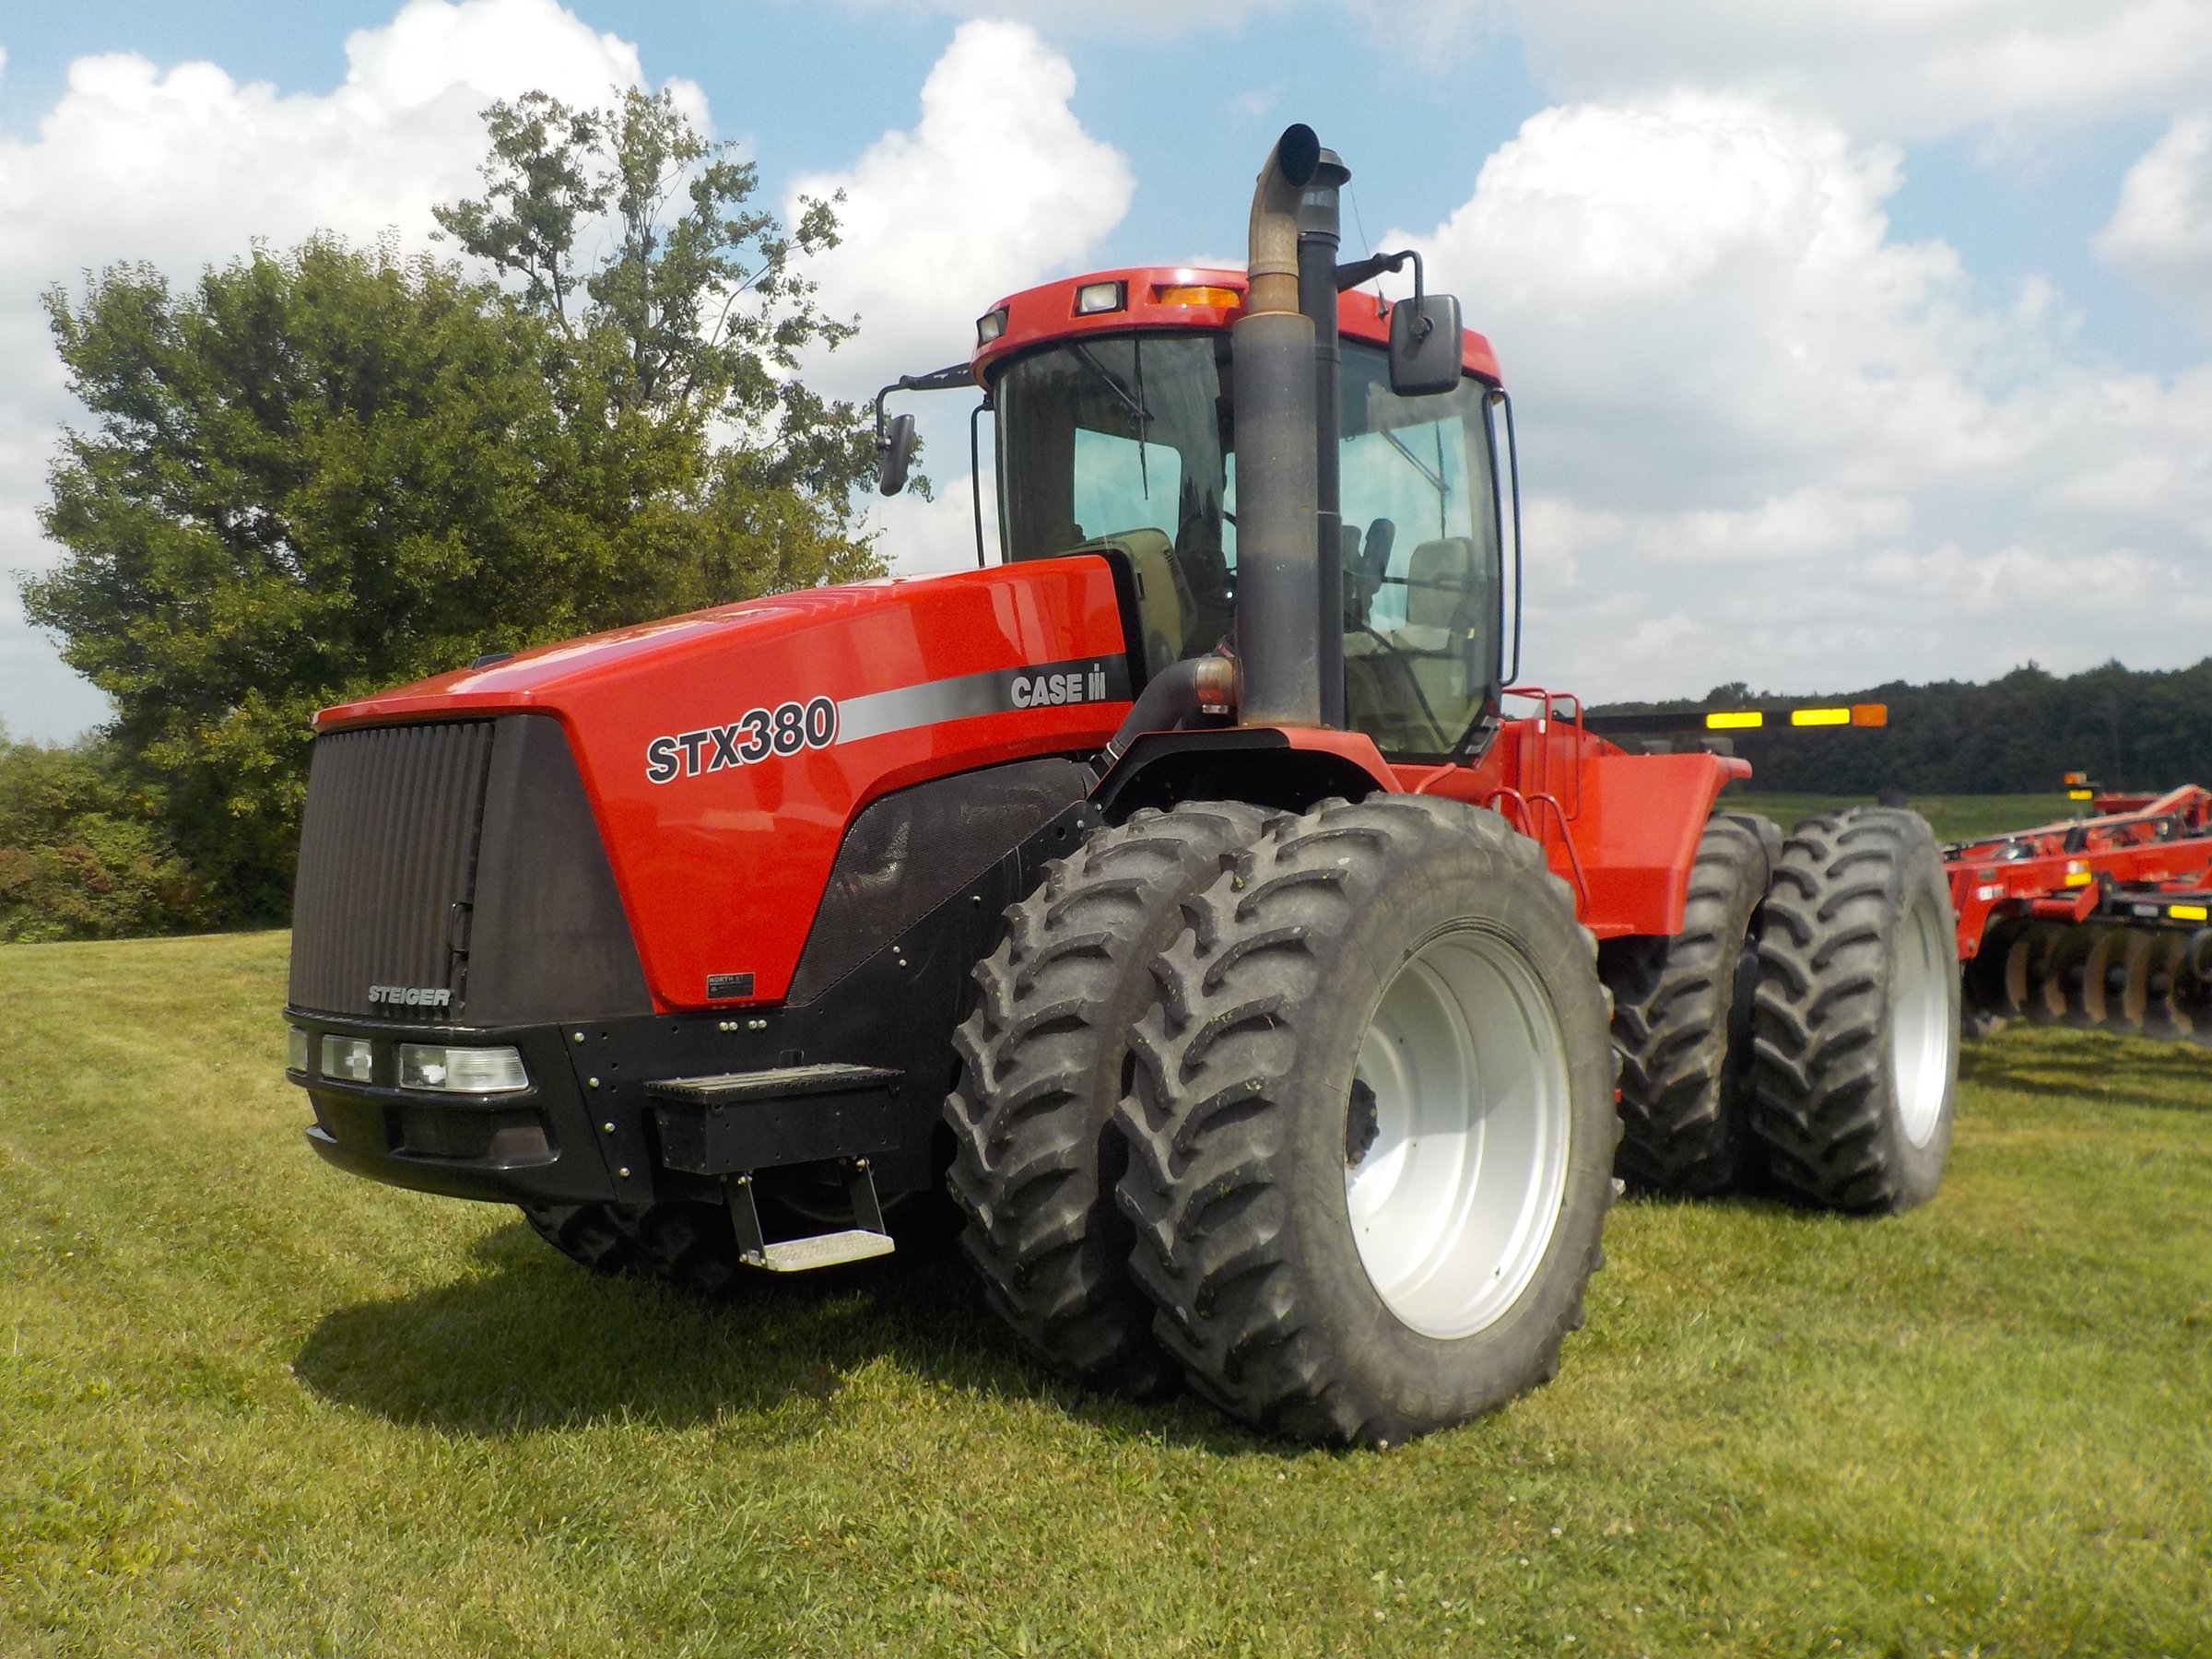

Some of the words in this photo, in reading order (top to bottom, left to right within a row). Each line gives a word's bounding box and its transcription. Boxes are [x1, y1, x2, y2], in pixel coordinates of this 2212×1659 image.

[1011, 674, 1083, 709] CASE
[646, 695, 837, 784] STX380
[369, 985, 451, 1006] STEIGER
